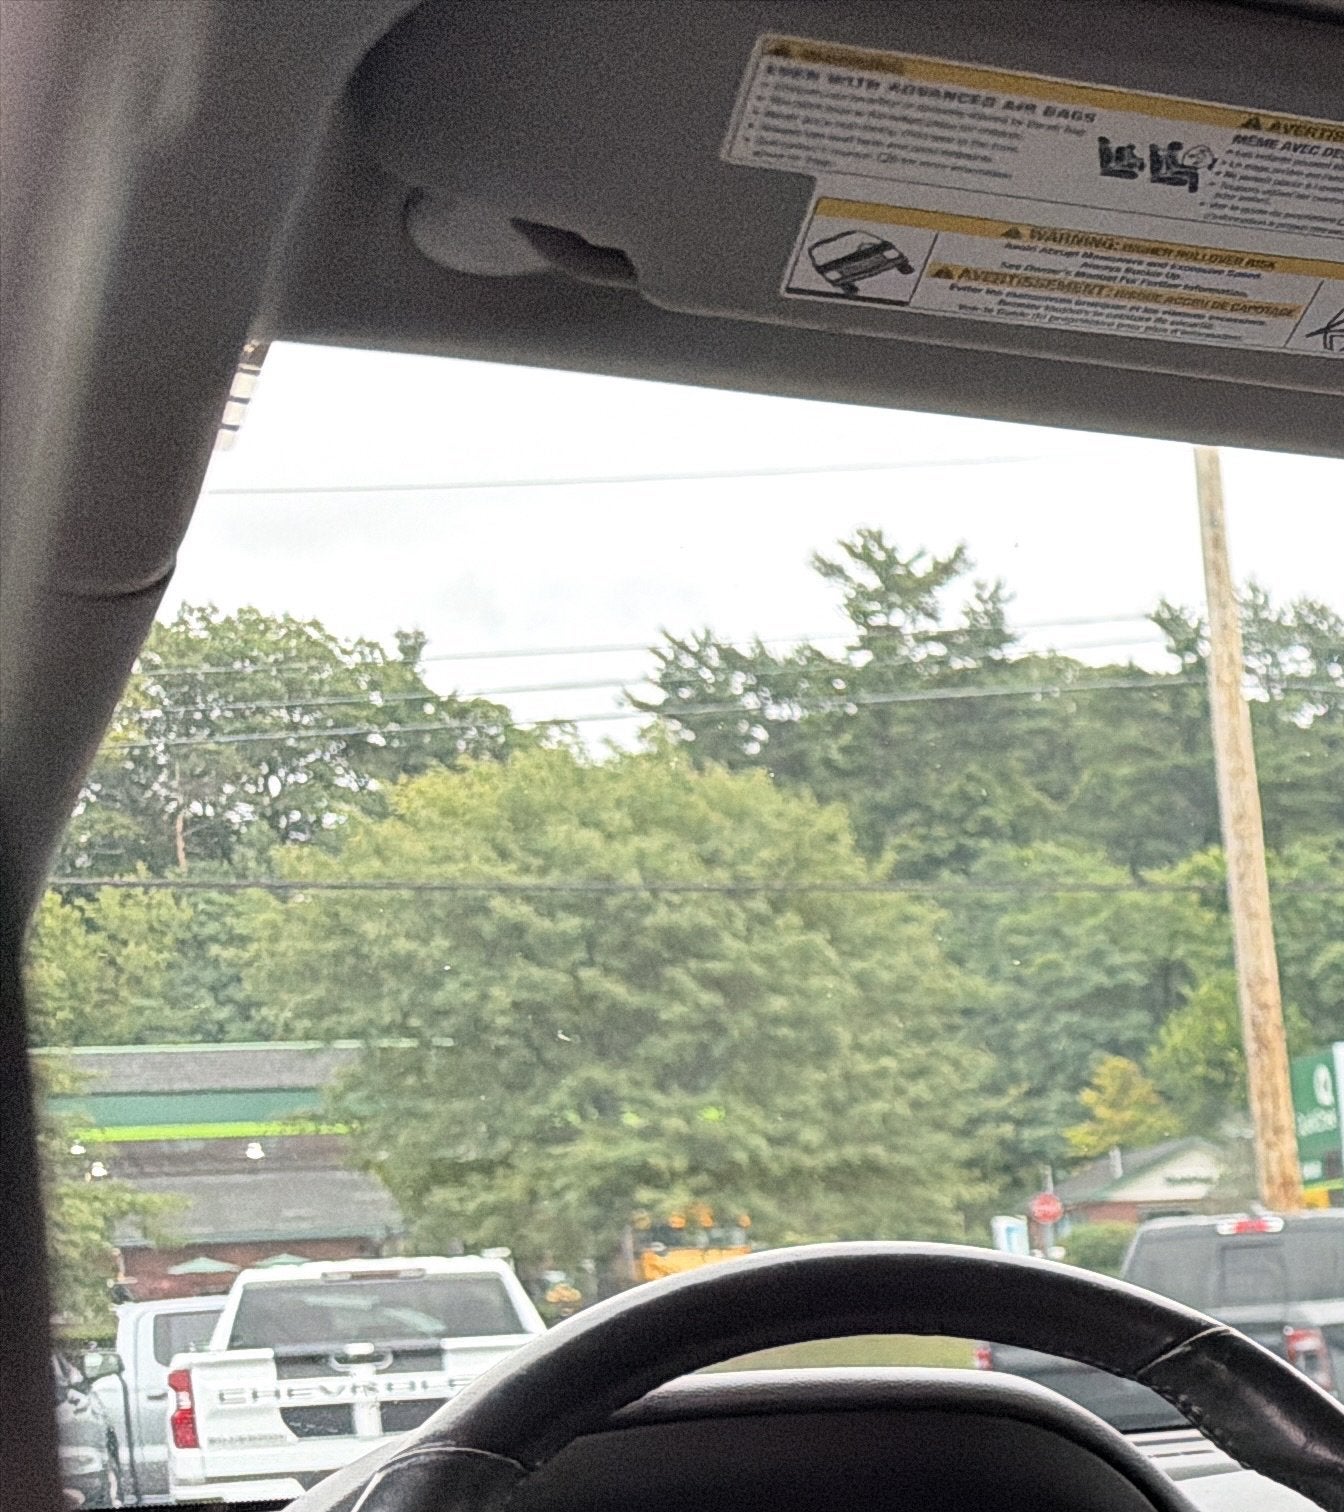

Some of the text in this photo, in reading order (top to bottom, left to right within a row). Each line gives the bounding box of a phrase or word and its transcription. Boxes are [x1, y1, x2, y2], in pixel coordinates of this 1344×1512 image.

[889, 81, 997, 107] ADVANCED
[1002, 100, 1037, 113] AIR
[1043, 105, 1097, 123] BAGS
[1280, 140, 1321, 156] AVEC
[218, 1377, 478, 1406] CHEVROLE
